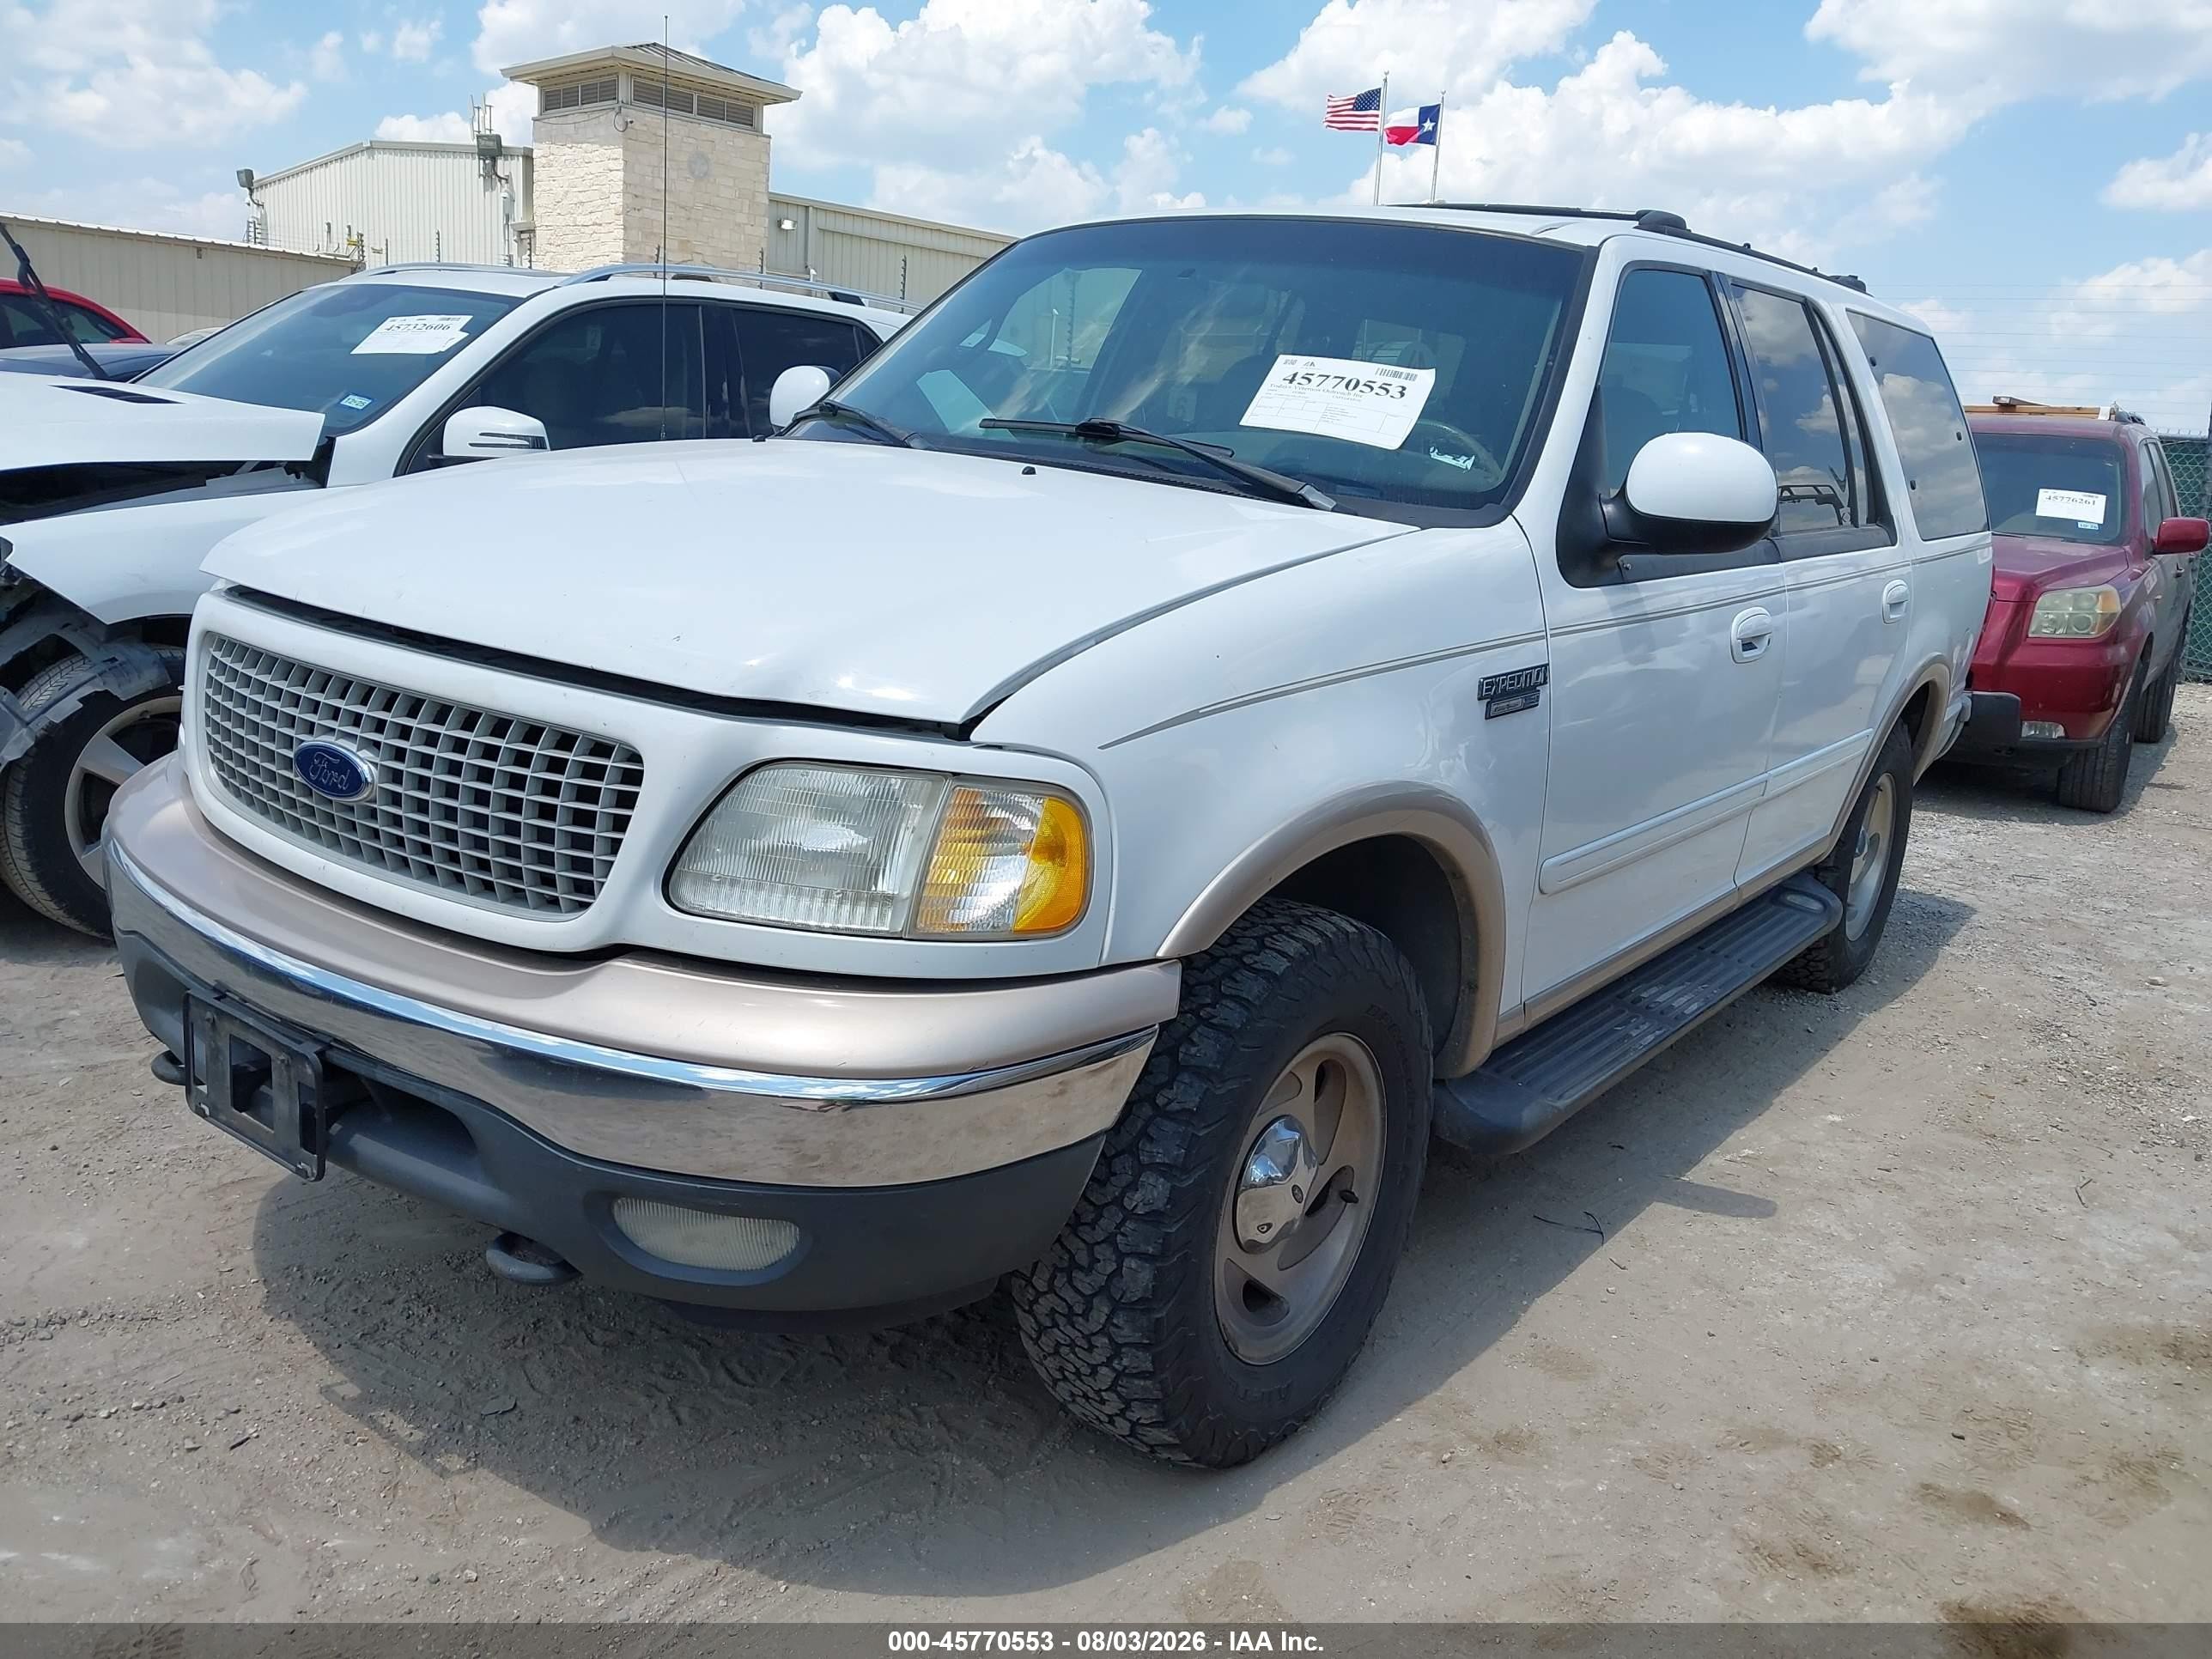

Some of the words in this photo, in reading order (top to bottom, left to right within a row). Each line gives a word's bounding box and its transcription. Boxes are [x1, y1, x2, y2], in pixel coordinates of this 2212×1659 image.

[384, 322, 453, 331] 45732606
[1282, 371, 1407, 400] 45770553
[2045, 495, 2096, 506] 45776261
[309, 751, 351, 791] Ford
